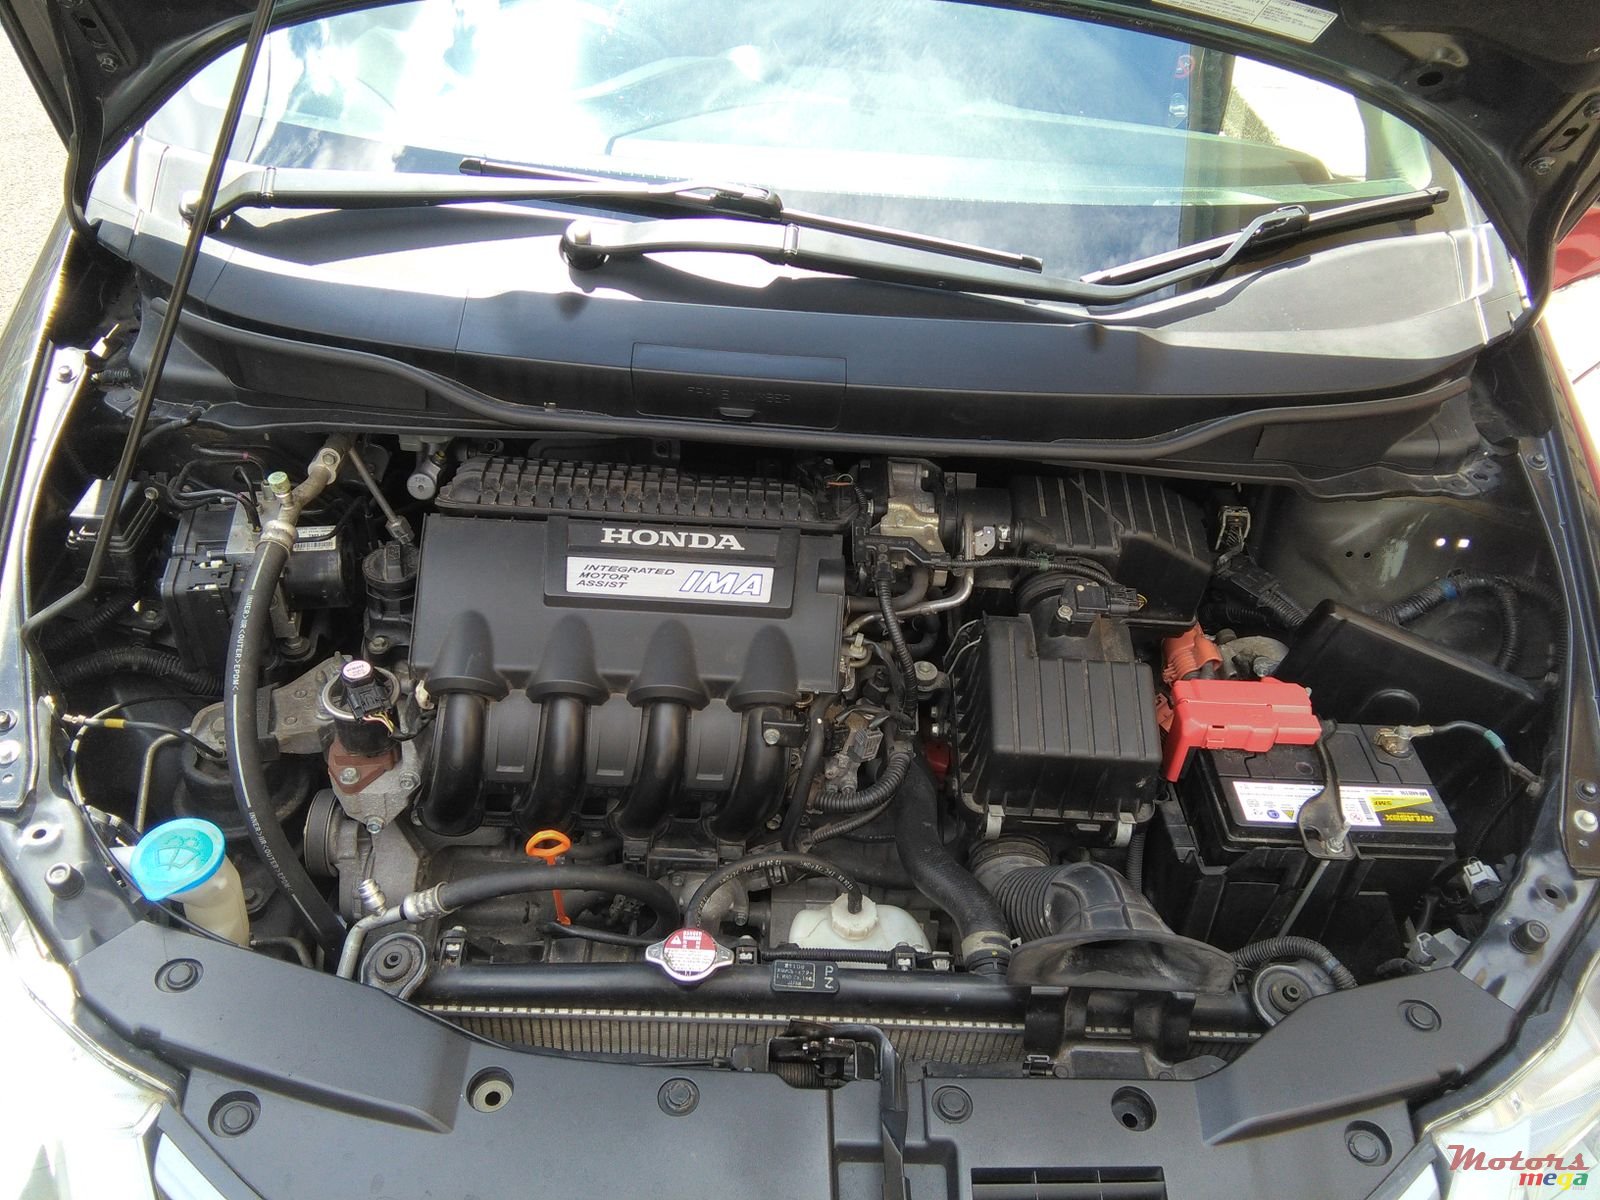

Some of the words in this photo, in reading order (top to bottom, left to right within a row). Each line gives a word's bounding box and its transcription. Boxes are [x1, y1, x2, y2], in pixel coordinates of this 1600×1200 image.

[600, 527, 745, 551] HONDA
[583, 564, 676, 575] INTEGRATED
[578, 572, 630, 581] MOTOR
[576, 579, 628, 589] ASSIST
[678, 569, 764, 597] IMA
